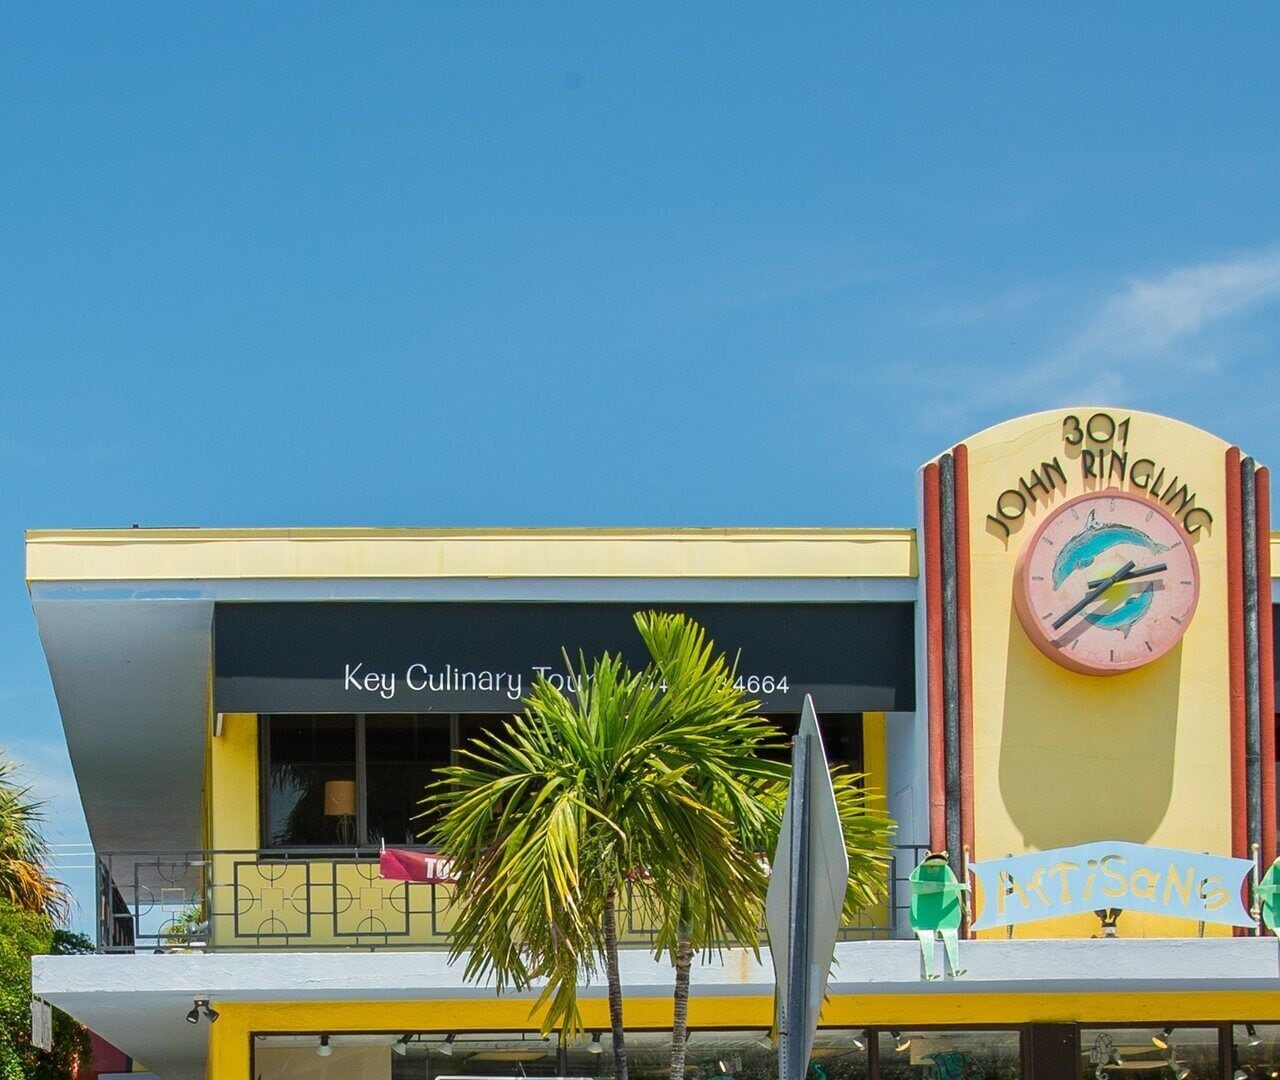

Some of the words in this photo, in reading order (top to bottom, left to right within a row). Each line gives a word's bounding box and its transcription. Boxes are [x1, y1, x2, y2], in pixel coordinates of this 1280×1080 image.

[1062, 412, 1132, 446] 301
[985, 456, 1068, 538] JOHN
[1081, 448, 1214, 536] RINGLING
[344, 662, 396, 700] Key
[406, 663, 521, 700] Culinary
